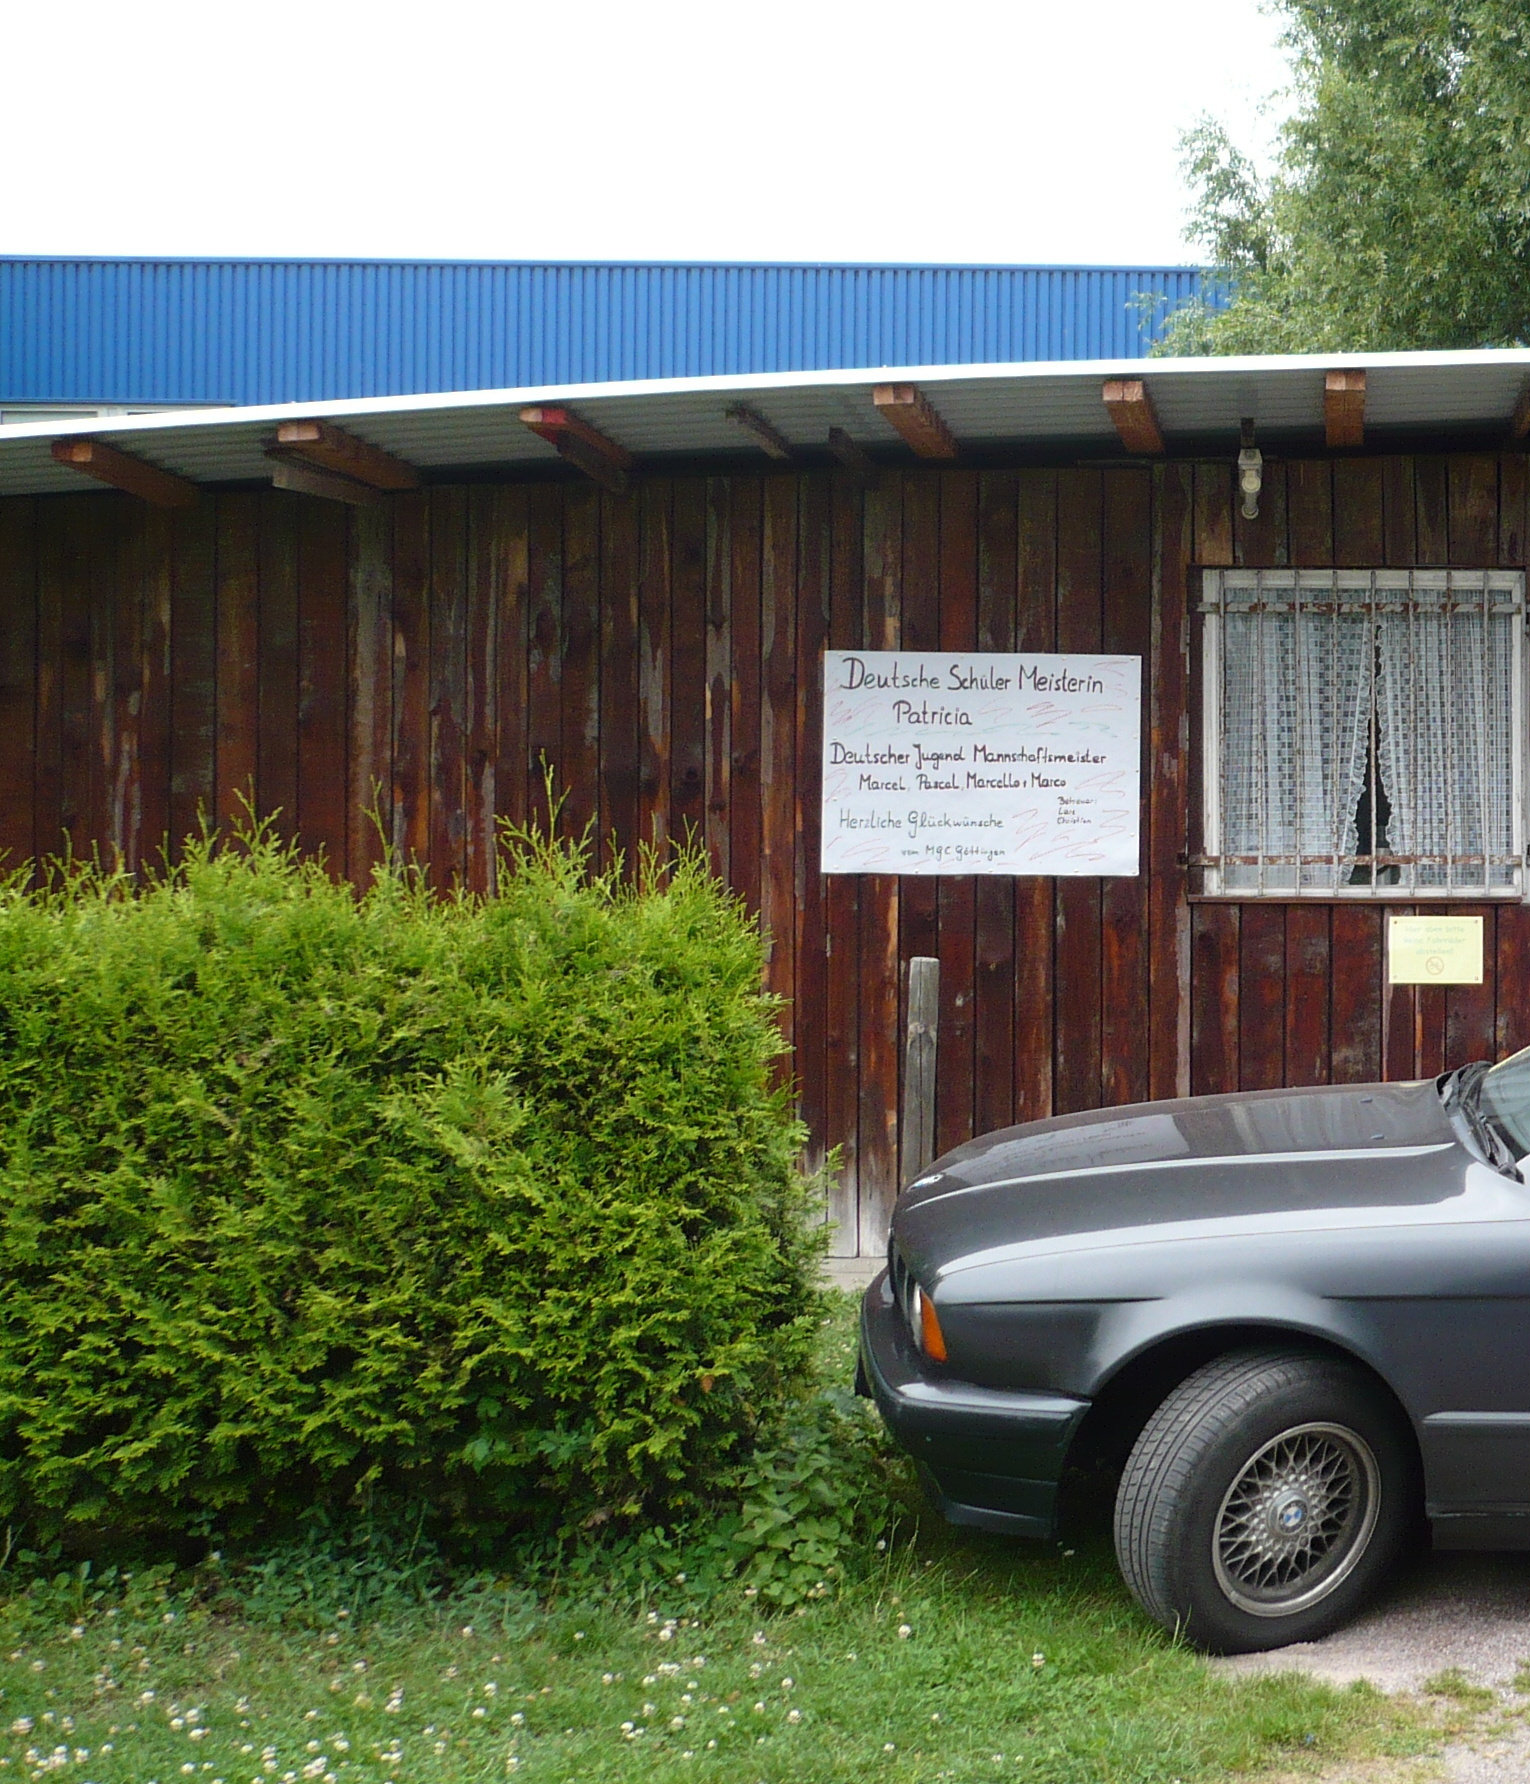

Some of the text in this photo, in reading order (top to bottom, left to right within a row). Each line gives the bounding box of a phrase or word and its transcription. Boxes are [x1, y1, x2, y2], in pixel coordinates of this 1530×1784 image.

[839, 657, 1103, 694] Deutsche Schüler Meisterin
[893, 699, 973, 725] Patricia
[829, 742, 1107, 770] Deutscher Jugend Mannschaftsmeister
[1031, 772, 1067, 788] Marco
[839, 808, 1004, 838] Herzliche Glückwünsche
